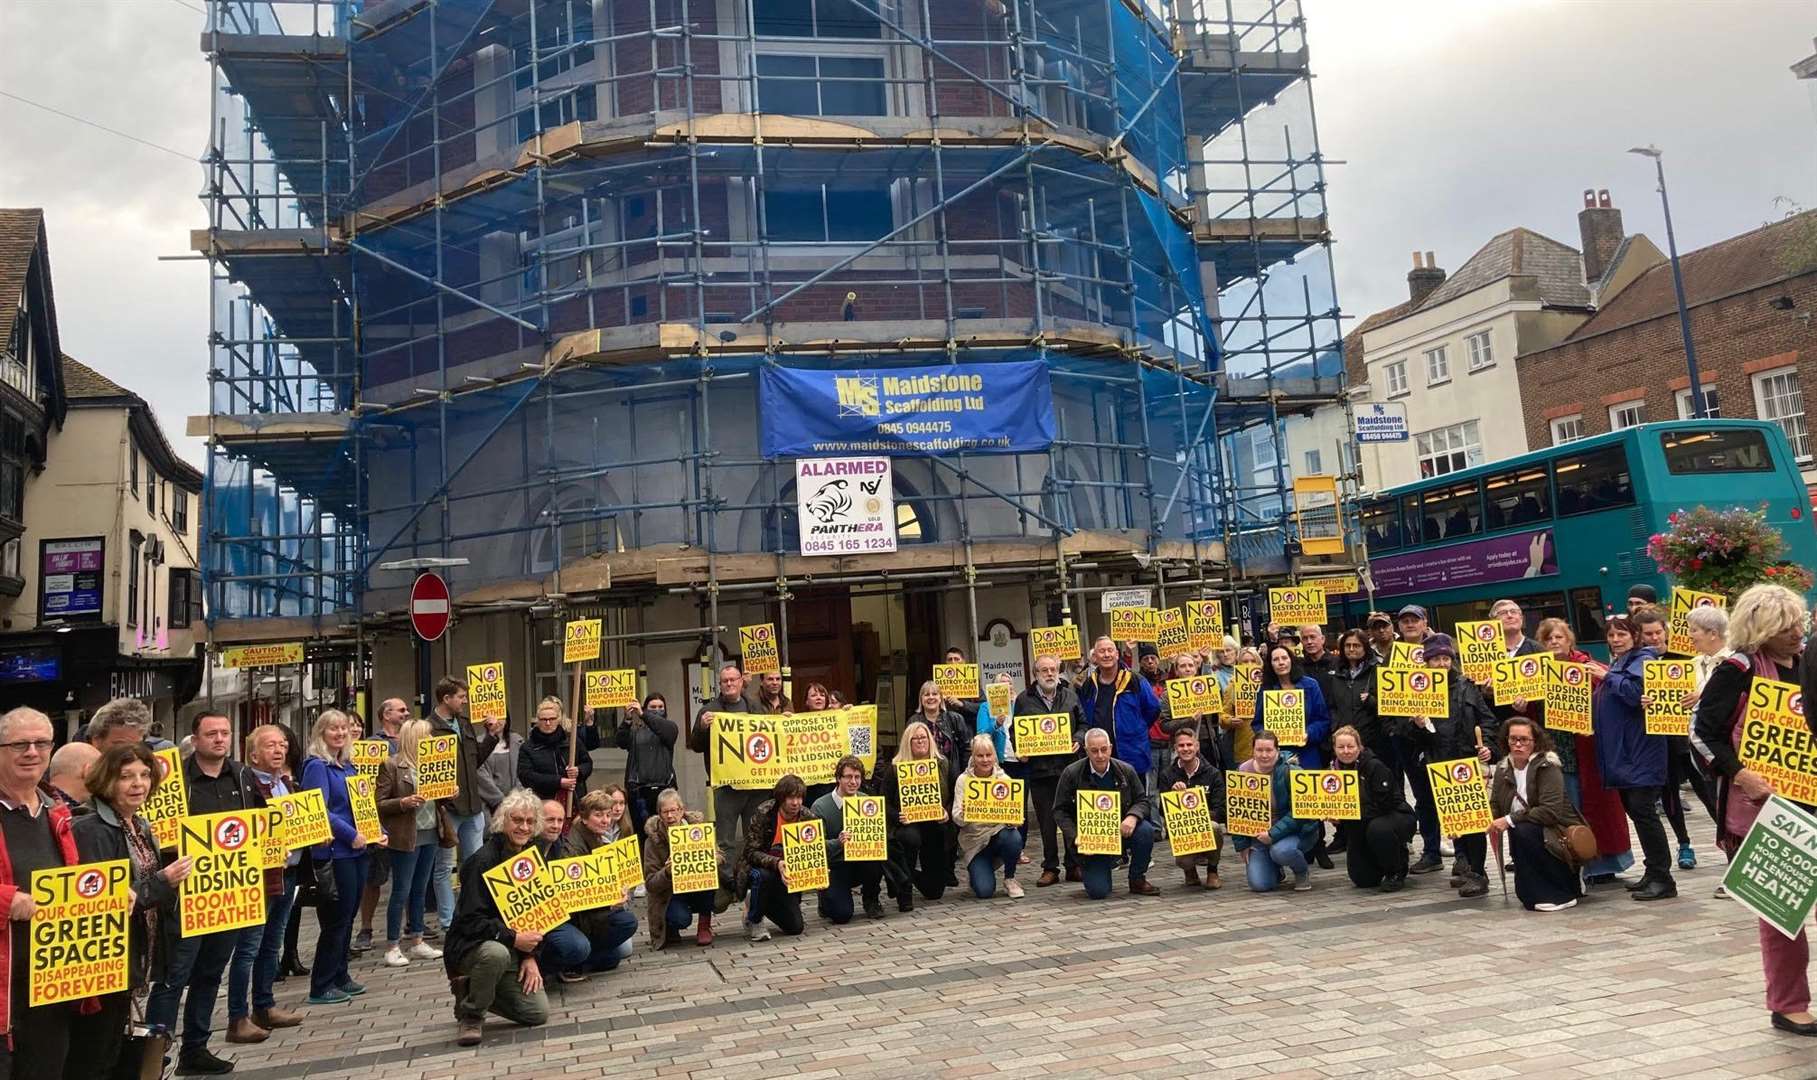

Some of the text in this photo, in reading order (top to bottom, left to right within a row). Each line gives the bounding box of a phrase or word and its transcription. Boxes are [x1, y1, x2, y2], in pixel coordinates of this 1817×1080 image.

[883, 374, 983, 396] Maidstone
[885, 396, 984, 414] Scaffolding Ltd
[878, 421, 951, 434] 0845 0944475
[813, 435, 1011, 451] www.maidstonescaffolding.co.uk
[800, 461, 888, 476] ALARMED
[811, 522, 883, 534] PANTHERA
[805, 538, 893, 551] 0845 165 1234
[1189, 624, 1221, 634] LIDSING
[1193, 617, 1216, 626] GIVE
[1457, 622, 1503, 644] NO!
[243, 646, 285, 655] CAUTION
[1467, 642, 1498, 653] GIVE
[240, 658, 289, 666] OVERHEAD
[1462, 651, 1506, 664] LIDSING
[982, 662, 1022, 670] Maidstone
[1381, 669, 1445, 692] STOP
[1546, 663, 1590, 687] NO!
[1520, 684, 1539, 693] BUILT
[1546, 683, 1589, 696] LIDSING
[1547, 691, 1590, 704] GARDEN
[1546, 699, 1590, 713] VILLAGE
[782, 716, 836, 727] OPPOSE THE
[1750, 709, 1776, 724] OUR
[718, 718, 776, 732] WE SAY
[784, 724, 824, 734] BUILDING
[786, 731, 841, 747] 2,000+
[718, 732, 780, 765] NO!
[786, 743, 842, 755] NEW HOMES
[787, 750, 843, 763] IN LIDSING
[419, 759, 455, 773] GREEN
[751, 763, 819, 777] GET INVOLVED
[419, 770, 456, 784] SPACES
[1428, 760, 1480, 788] NO!
[900, 782, 939, 796] GREEN
[1294, 773, 1355, 794] STOP
[1433, 782, 1482, 798] LIDSING
[901, 793, 940, 807] SPACES
[1228, 795, 1269, 810] GREEN
[1436, 791, 1484, 807] GARDEN
[1078, 811, 1118, 820] LIDSING
[1166, 807, 1206, 822] LIDSING
[1228, 807, 1270, 821] SPACES
[1437, 800, 1487, 816] VILLAGE
[308, 813, 325, 826] OUR
[1079, 819, 1118, 827] GARDEN
[1168, 815, 1208, 829] GARDEN
[1440, 810, 1488, 824] MUST BE
[1078, 827, 1119, 835] VILLAGE
[1169, 823, 1210, 837] VILLAGE
[1771, 814, 1808, 839] SAY
[181, 813, 258, 856] NO!
[1761, 831, 1779, 850] TO
[672, 848, 714, 864] GREEN
[785, 842, 822, 855] LIDSING
[194, 849, 248, 874] GIVE
[786, 850, 824, 864] GARDEN
[552, 854, 615, 884] DON'T
[673, 860, 716, 876] SPACES
[787, 859, 825, 872] VILLAGE
[1755, 843, 1815, 887] MORE HOUSES
[183, 865, 260, 897] LIDSING
[485, 850, 544, 898] NO!
[596, 875, 617, 885] OUR
[1749, 851, 1810, 897] IN LENHAM
[34, 865, 125, 906] STOP
[504, 876, 543, 905] GIVE
[1741, 861, 1804, 911] HEATH
[184, 886, 260, 914] ROOM TO
[502, 883, 556, 921] LIDSING
[35, 897, 124, 923] OUR CRUCIAL
[185, 902, 261, 932] BREATHE!
[508, 896, 561, 931] ROOM TO
[34, 911, 124, 947] GREEN
[34, 934, 125, 971] SPACES
[34, 970, 123, 1003] FOREVER!
